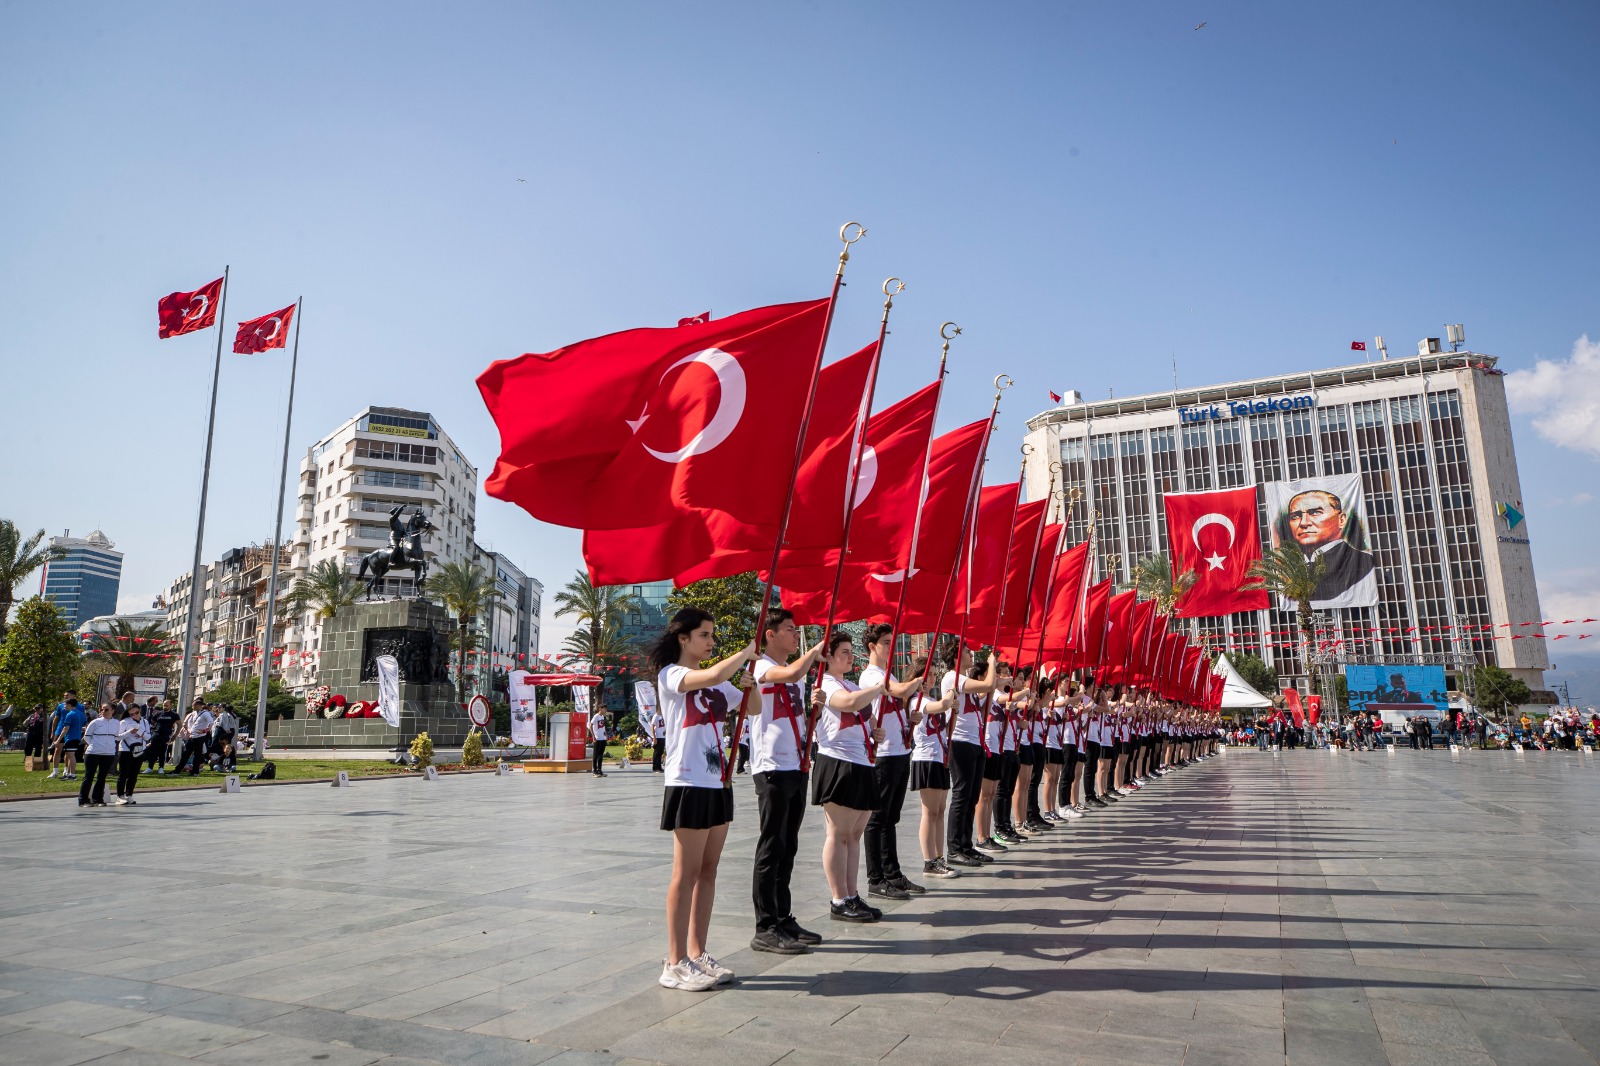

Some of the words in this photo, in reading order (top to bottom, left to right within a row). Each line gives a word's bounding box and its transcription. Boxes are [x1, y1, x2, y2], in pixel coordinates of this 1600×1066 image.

[1178, 404, 1220, 423] Türk
[1226, 394, 1313, 417] Telekom
[230, 778, 236, 786] 7
